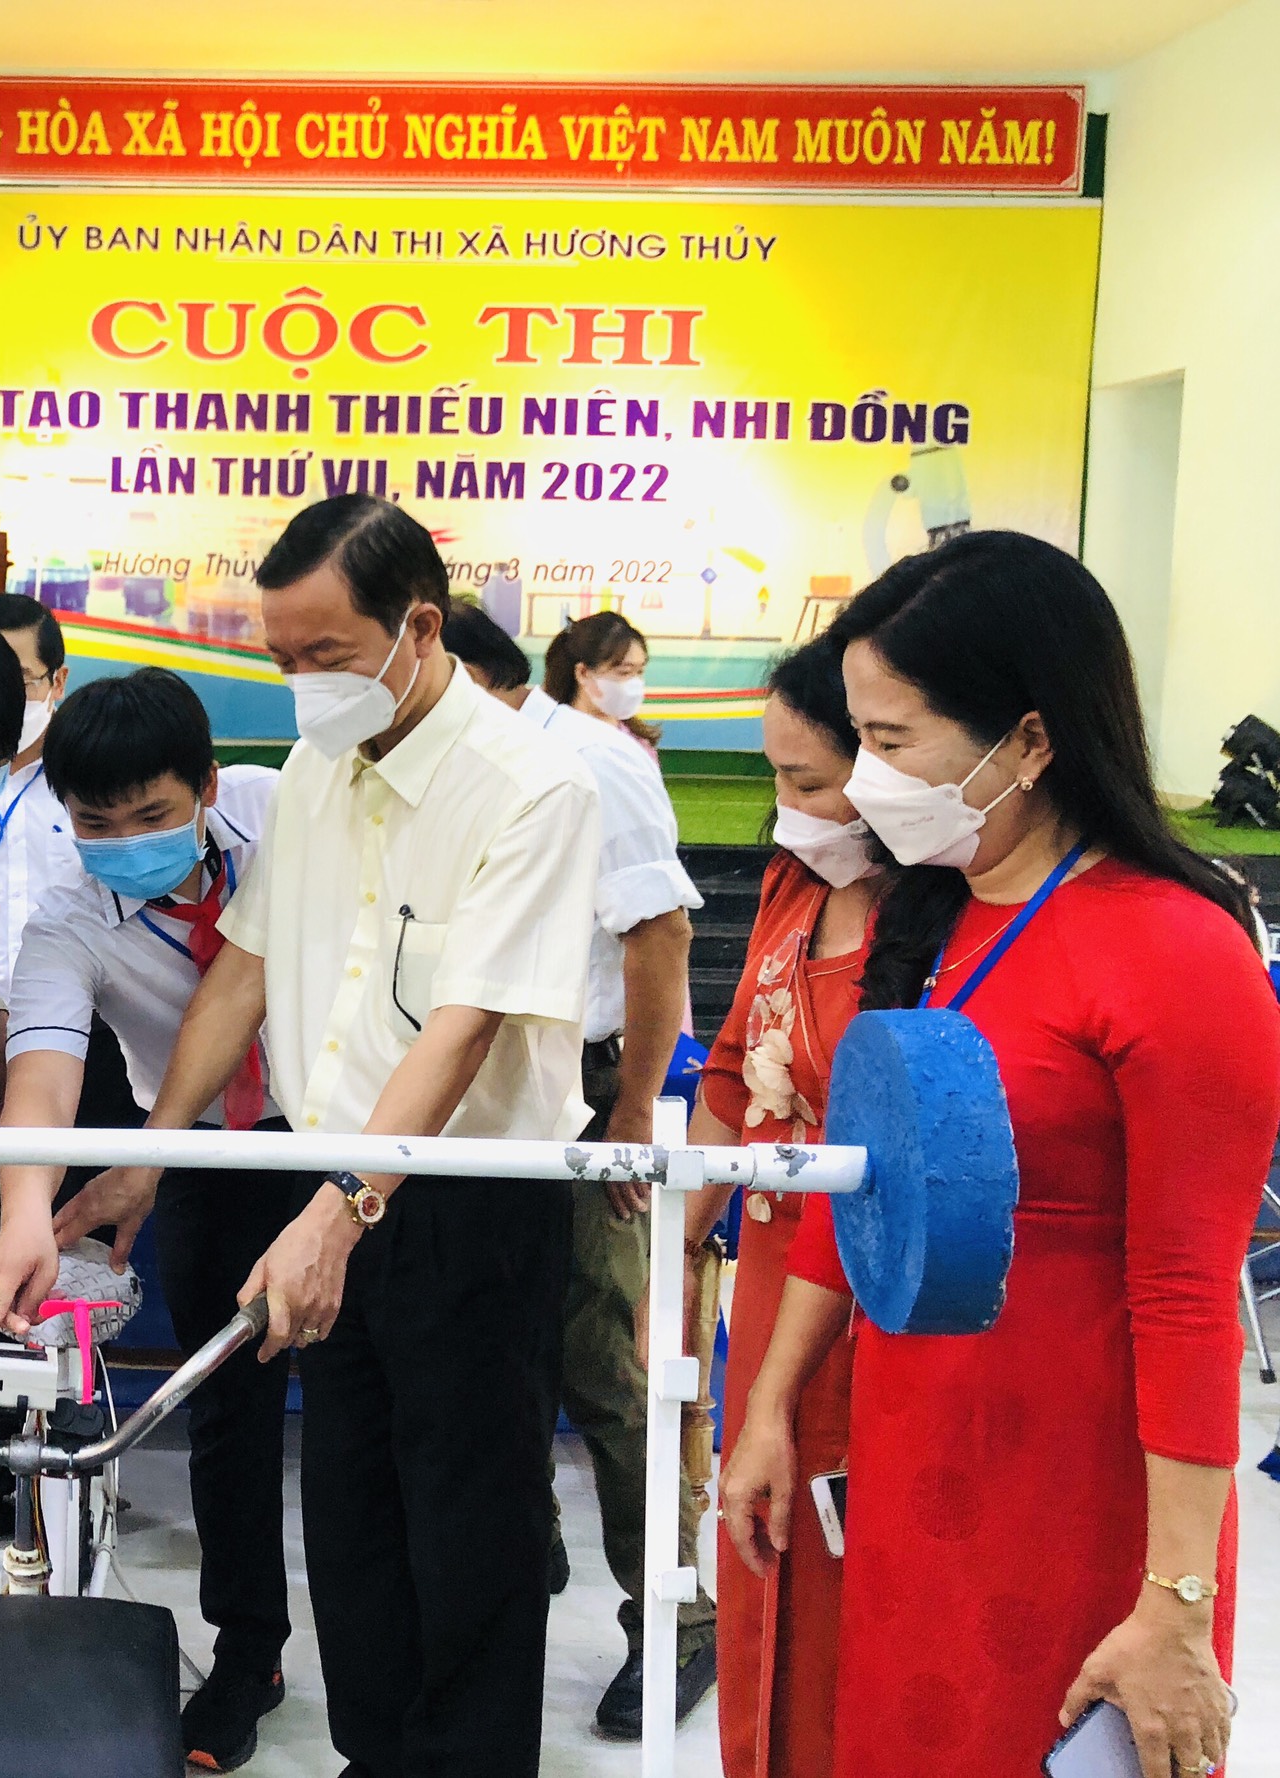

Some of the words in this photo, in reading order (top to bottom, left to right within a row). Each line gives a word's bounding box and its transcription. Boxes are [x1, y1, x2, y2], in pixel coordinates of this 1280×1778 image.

[16, 97, 112, 156] HÒA
[122, 99, 187, 157] XÃ
[199, 99, 282, 168] HỘI
[295, 96, 389, 159] CHỦ
[403, 103, 548, 160] NGHĨA
[559, 103, 667, 172] VIỆT
[679, 116, 780, 163] NAM
[792, 106, 926, 165] MUÔN
[939, 106, 1057, 165] NĂM!
[17, 213, 69, 250] ỦY
[84, 226, 160, 251] BAN
[175, 221, 282, 254] NHÂN
[297, 223, 378, 256] DÂN
[458, 225, 510, 257] XÃ
[525, 228, 667, 259] HƯƠNG
[680, 225, 779, 262] THỦY
[91, 286, 429, 380] CUỘC
[477, 306, 703, 366] THI
[118, 391, 312, 434] THANH
[328, 382, 504, 436] THIẾU
[523, 389, 674, 443] NIÊN,
[692, 400, 792, 440] NHI
[808, 389, 972, 447] ĐỒNG
[111, 444, 196, 494] LẦN
[212, 449, 313, 498] THỨ
[322, 459, 400, 501] VII,
[415, 453, 526, 501] NĂM
[541, 462, 671, 502] 2022
[103, 552, 192, 582] Hương
[443, 555, 493, 588] áng
[503, 557, 521, 582] 3
[533, 558, 595, 583] năm
[608, 559, 674, 584] 2022
